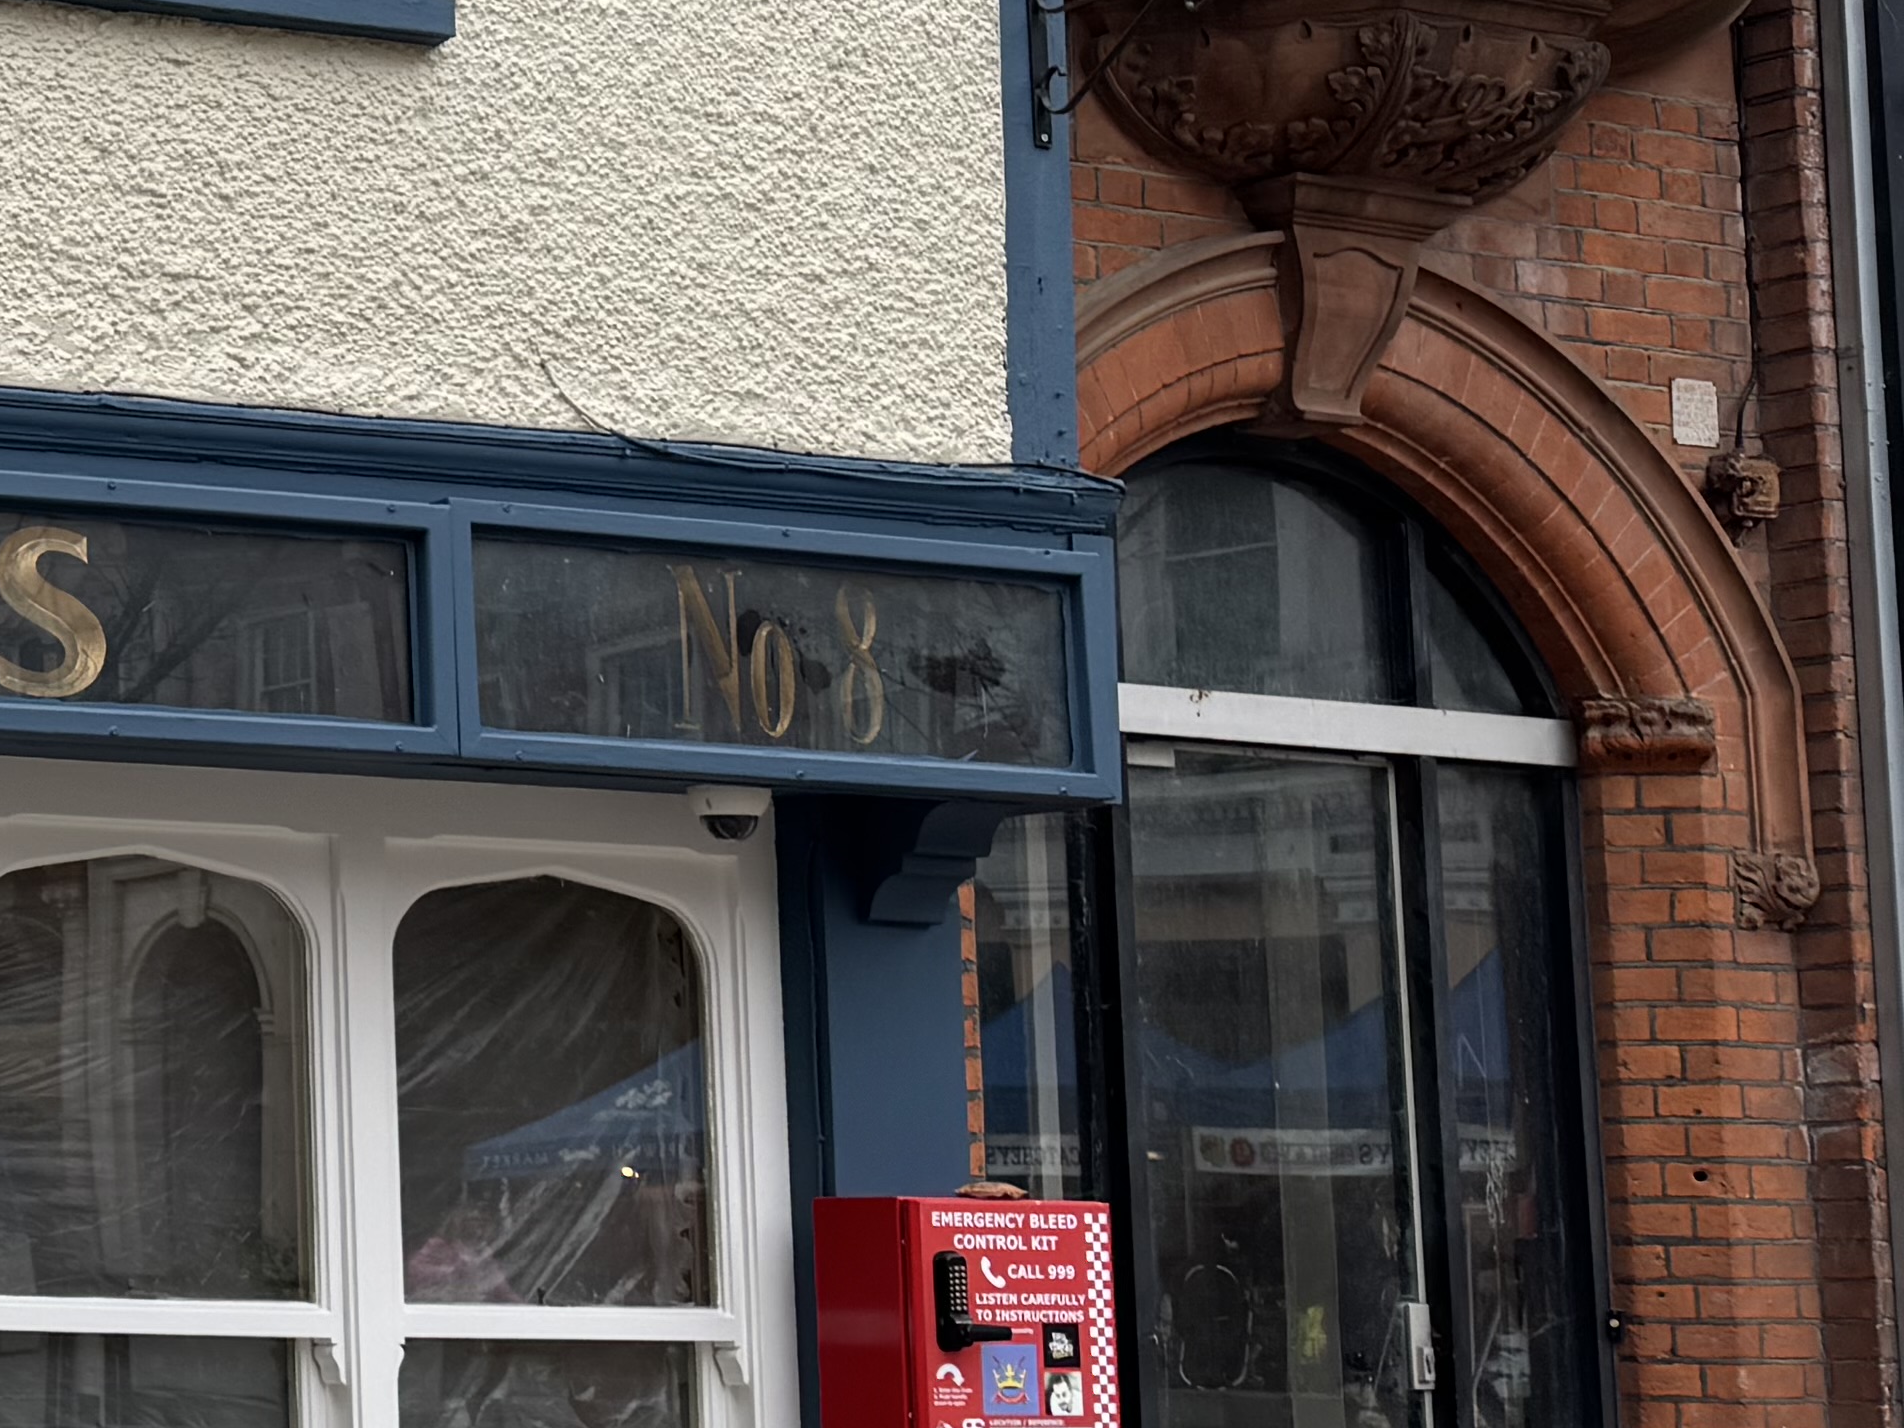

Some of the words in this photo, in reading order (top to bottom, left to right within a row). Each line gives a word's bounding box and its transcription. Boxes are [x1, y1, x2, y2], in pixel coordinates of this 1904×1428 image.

[666, 563, 795, 740] No
[835, 584, 884, 745] 8
[931, 1211, 1025, 1229] EMERGENCY
[1029, 1213, 1078, 1230] BLEED
[953, 1233, 1028, 1251] CONTROL
[1031, 1235, 1059, 1251] KIT
[1007, 1264, 1045, 1280] CALL
[1047, 1265, 1076, 1280] 999
[975, 1292, 1018, 1306] LISTEN
[1021, 1293, 1086, 1307] CAREFULLY
[975, 1309, 993, 1322] TO
[995, 1309, 1085, 1323] INSTRUCTIONS
